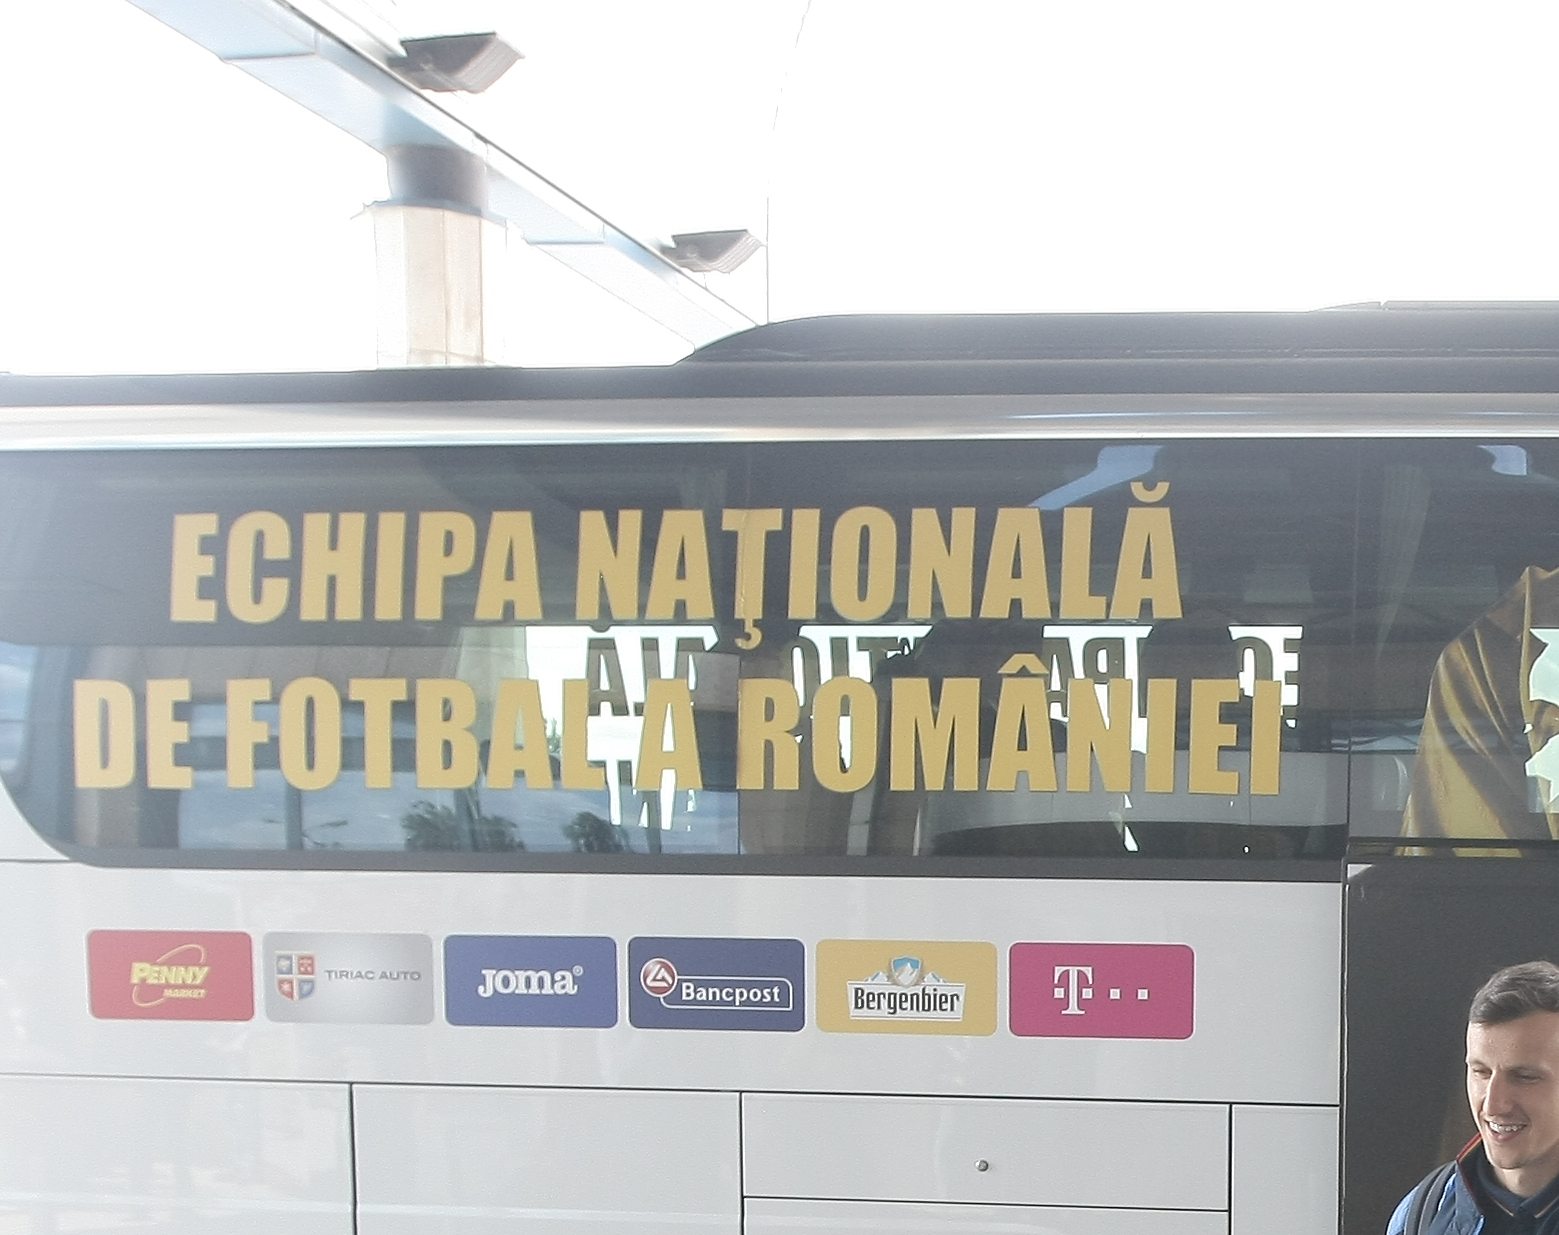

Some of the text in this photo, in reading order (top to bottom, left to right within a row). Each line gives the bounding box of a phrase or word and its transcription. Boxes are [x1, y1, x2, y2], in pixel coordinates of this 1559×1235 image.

[170, 510, 543, 623] ECHIPA
[73, 678, 195, 790] DE
[226, 676, 607, 790] FOTBAL
[635, 678, 703, 791] A
[736, 653, 1282, 795] ROMÂNIEI
[130, 961, 209, 985] PENNY
[324, 969, 422, 982] TIRIAC AUTO
[681, 981, 781, 1006] Bancpost
[853, 987, 960, 1015] Bergenbier
